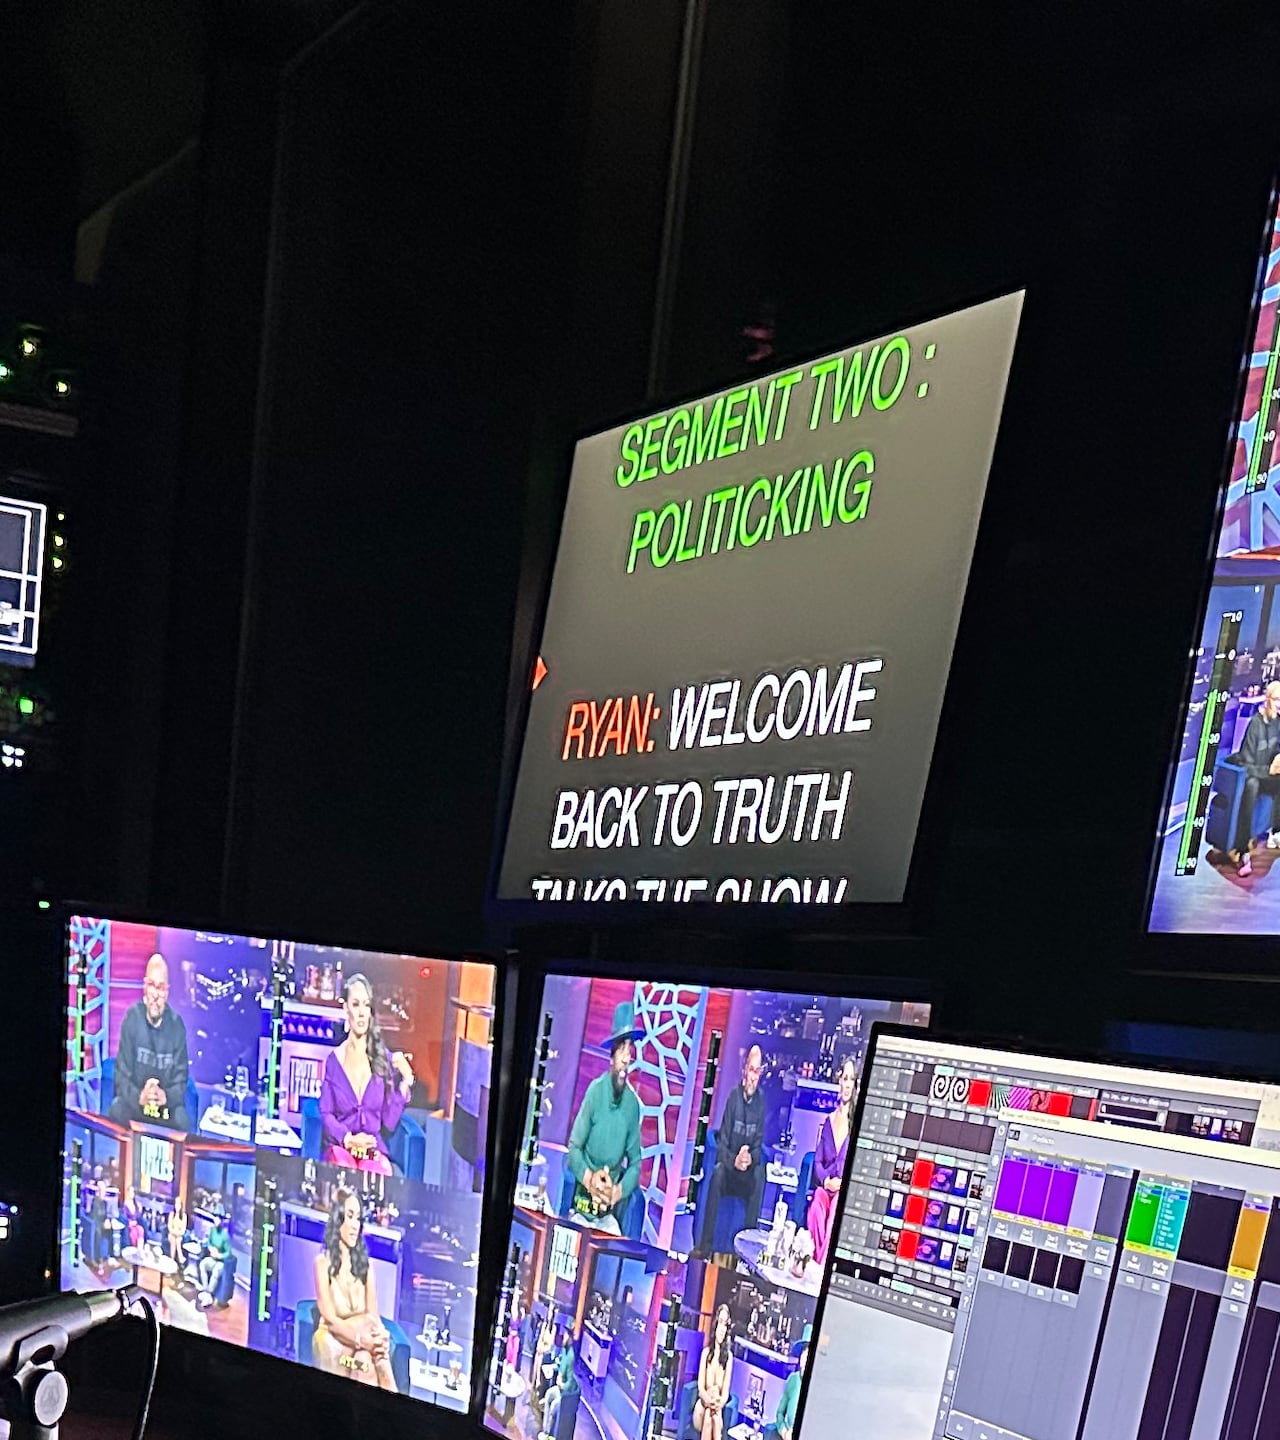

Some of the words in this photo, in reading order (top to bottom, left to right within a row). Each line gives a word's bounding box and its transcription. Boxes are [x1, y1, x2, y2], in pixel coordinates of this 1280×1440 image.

[616, 371, 802, 488] SEGMENT
[809, 335, 910, 431] TWO
[626, 450, 876, 574] POLITICKING
[562, 692, 662, 760] RYAN:
[668, 658, 883, 751] WELCOME
[550, 786, 651, 850] BACK
[652, 779, 703, 847] TO
[712, 770, 852, 845] TRUTH
